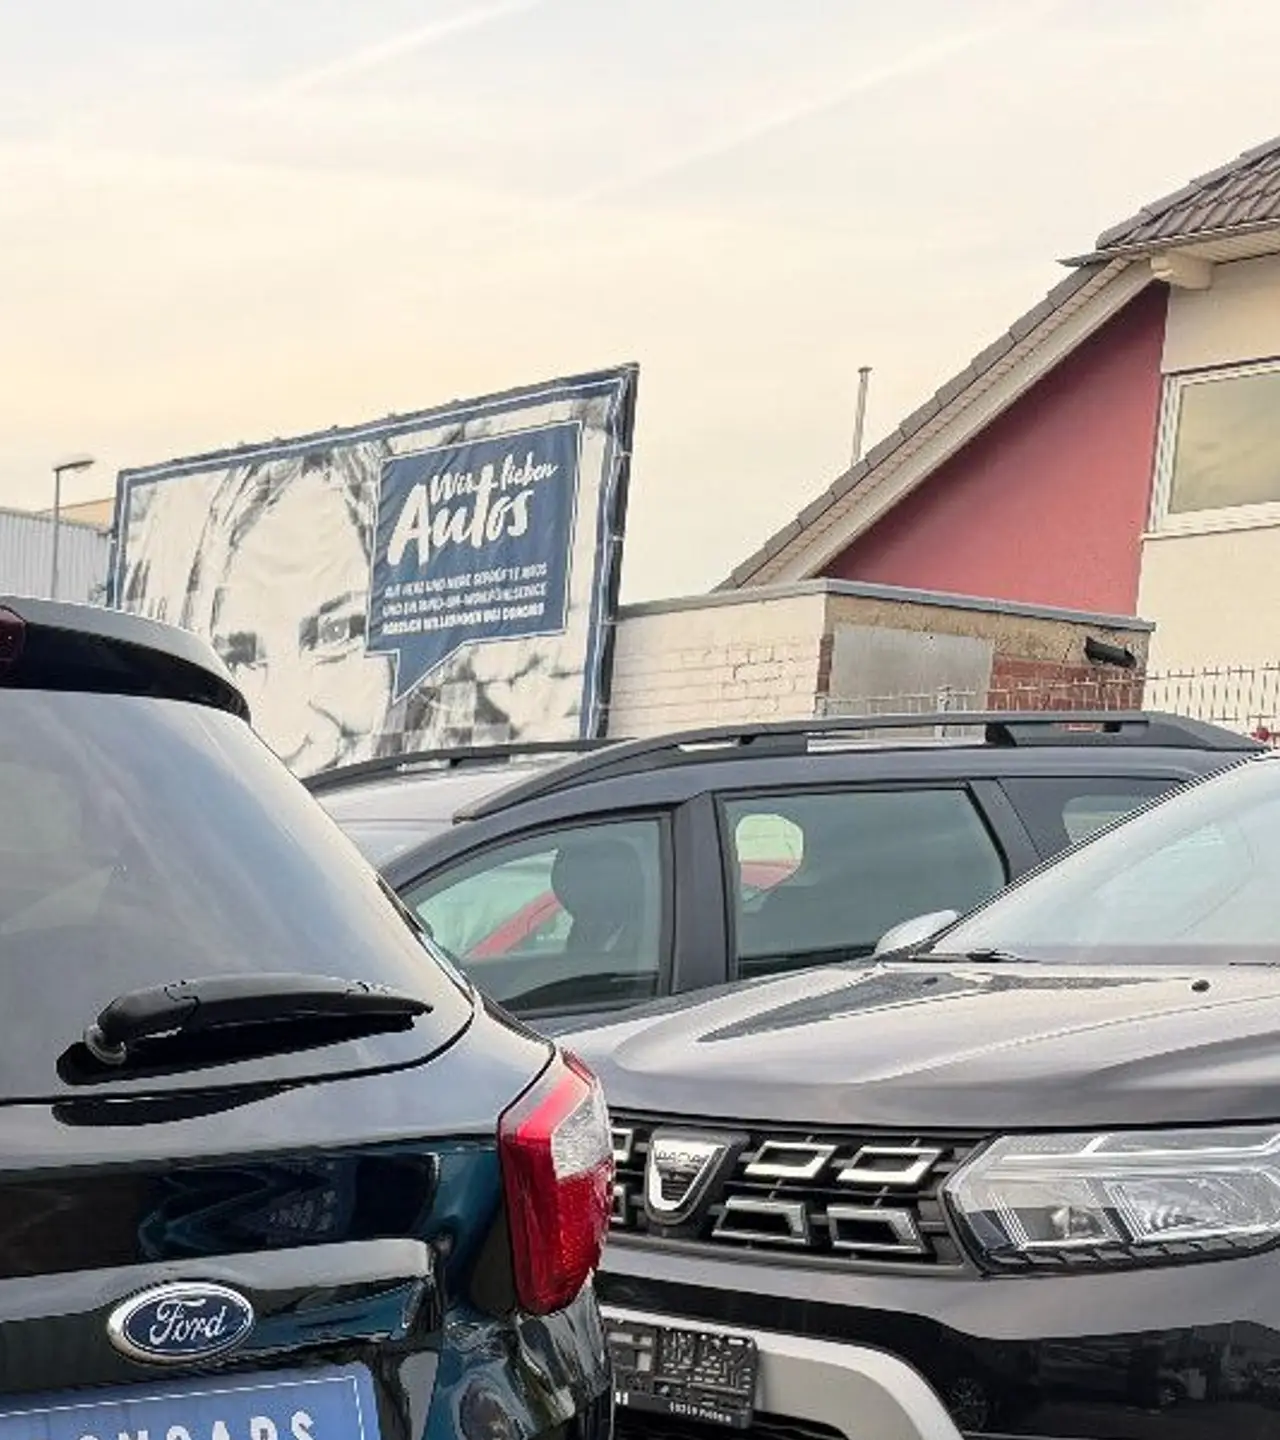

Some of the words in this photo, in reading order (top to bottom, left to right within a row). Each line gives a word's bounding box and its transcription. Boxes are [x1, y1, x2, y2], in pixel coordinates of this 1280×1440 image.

[500, 451, 559, 491] lieben
[386, 463, 535, 567] Autos
[150, 1297, 227, 1346] Ford
